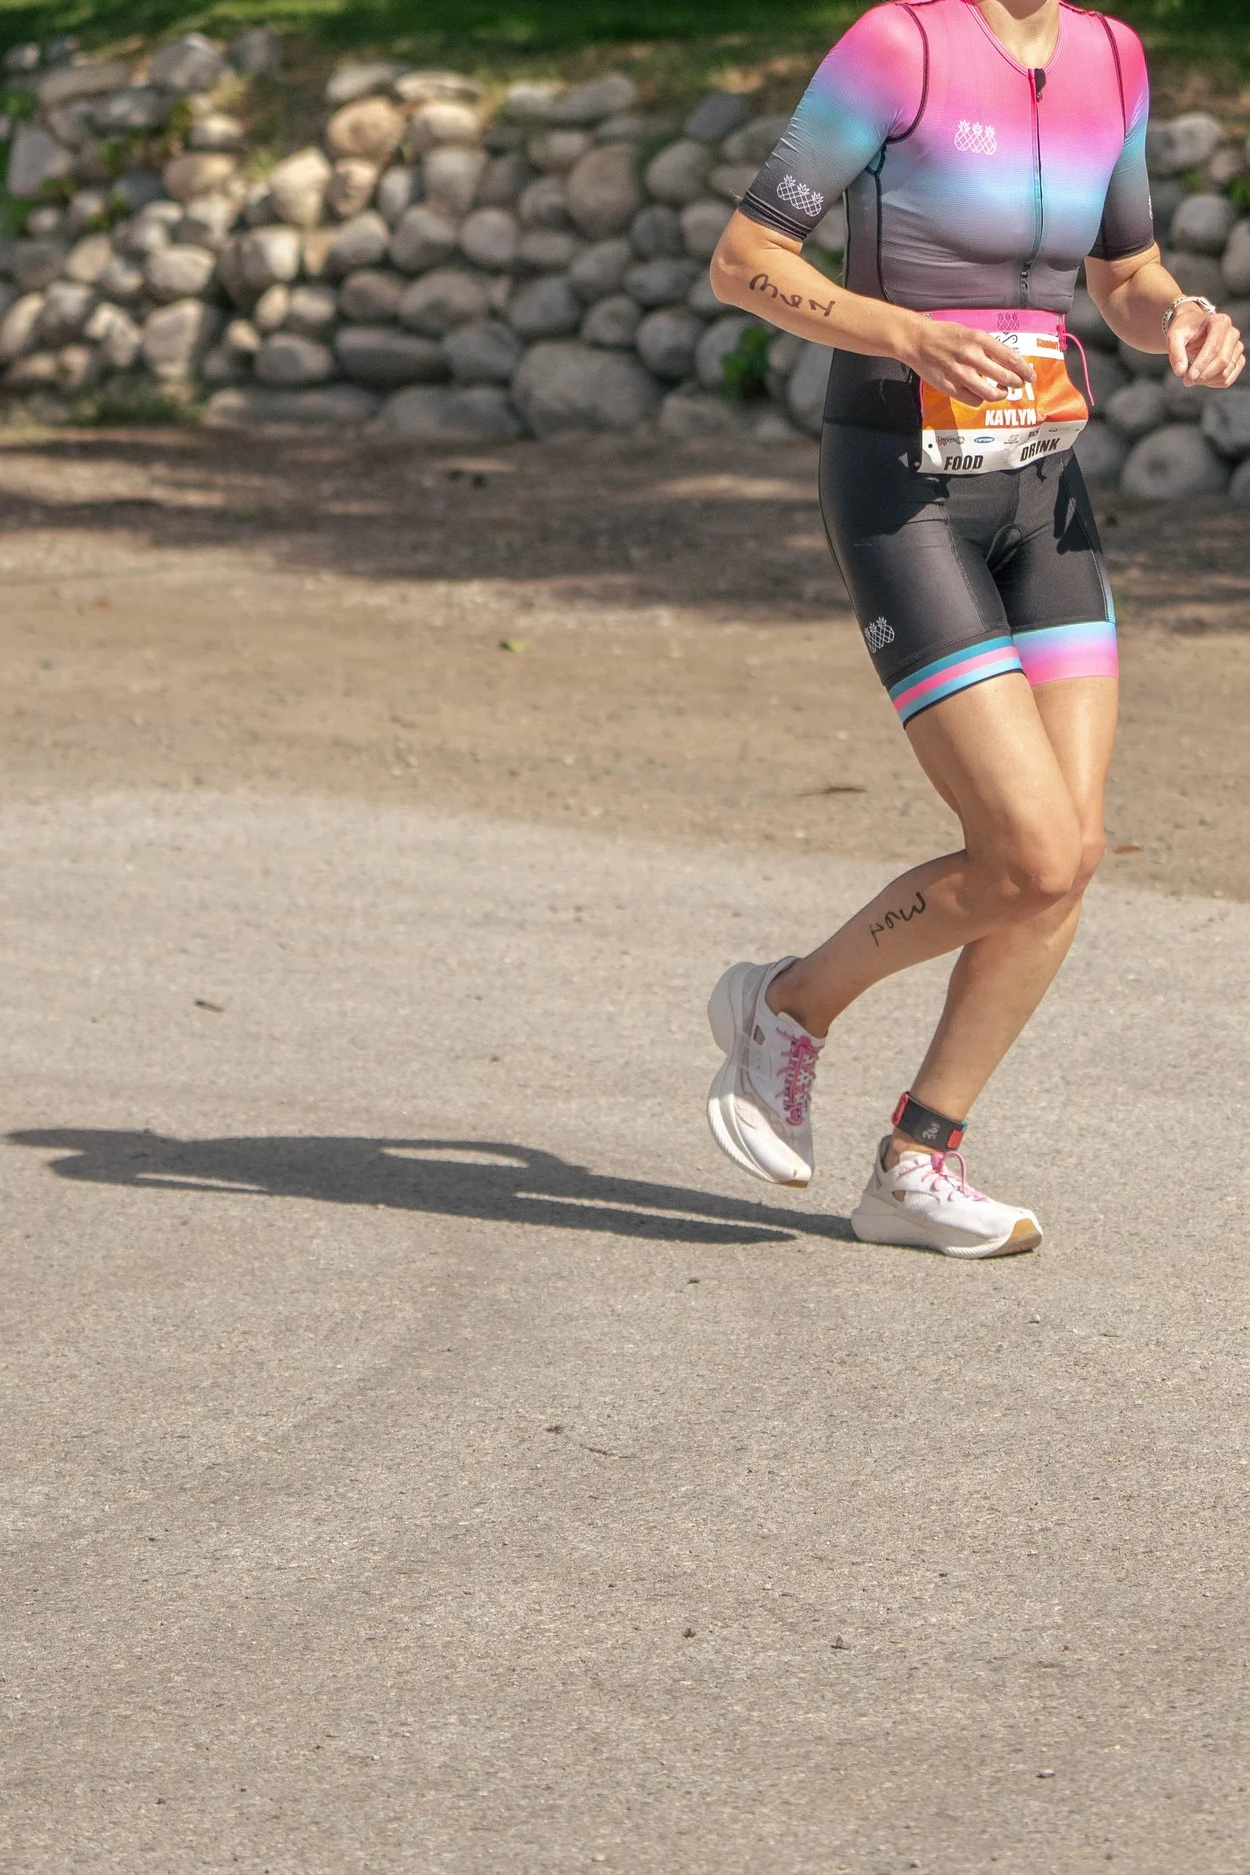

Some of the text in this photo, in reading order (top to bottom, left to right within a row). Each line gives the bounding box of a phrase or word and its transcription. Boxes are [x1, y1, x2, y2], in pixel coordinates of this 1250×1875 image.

[985, 409, 1037, 426] KAYLYN
[1020, 438, 1061, 462] DRINK
[943, 455, 984, 471] FOOD
